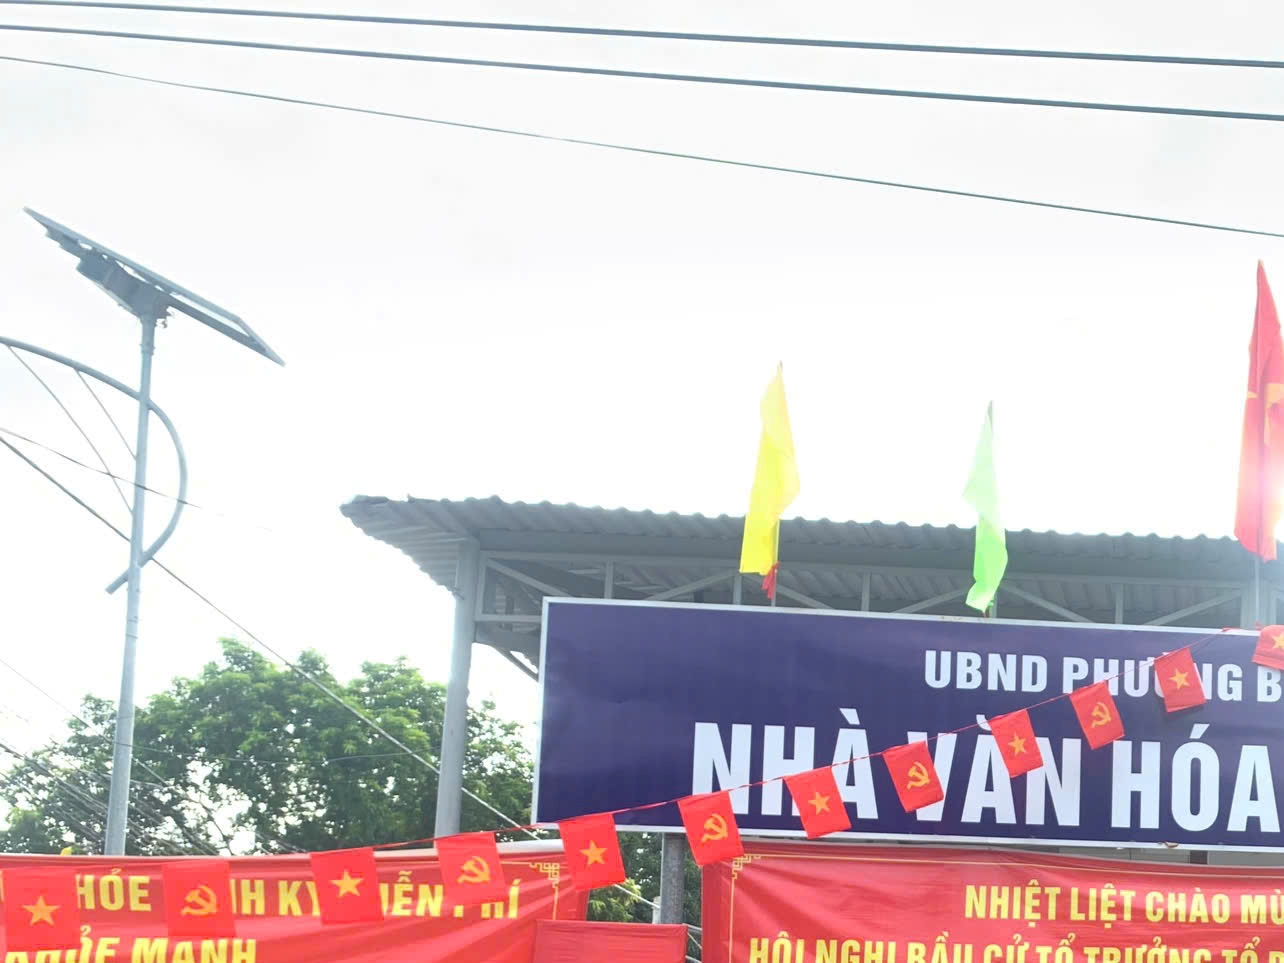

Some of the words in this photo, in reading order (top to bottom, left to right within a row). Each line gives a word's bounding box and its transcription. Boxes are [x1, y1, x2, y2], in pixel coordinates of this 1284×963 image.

[924, 650, 1048, 693] UBND
[693, 707, 878, 820] NHÀ
[1111, 723, 1281, 833] HÓA
[965, 879, 1061, 928] NHIỆT
[1070, 883, 1136, 929] LIỆT
[1145, 889, 1231, 925] CHÀO
